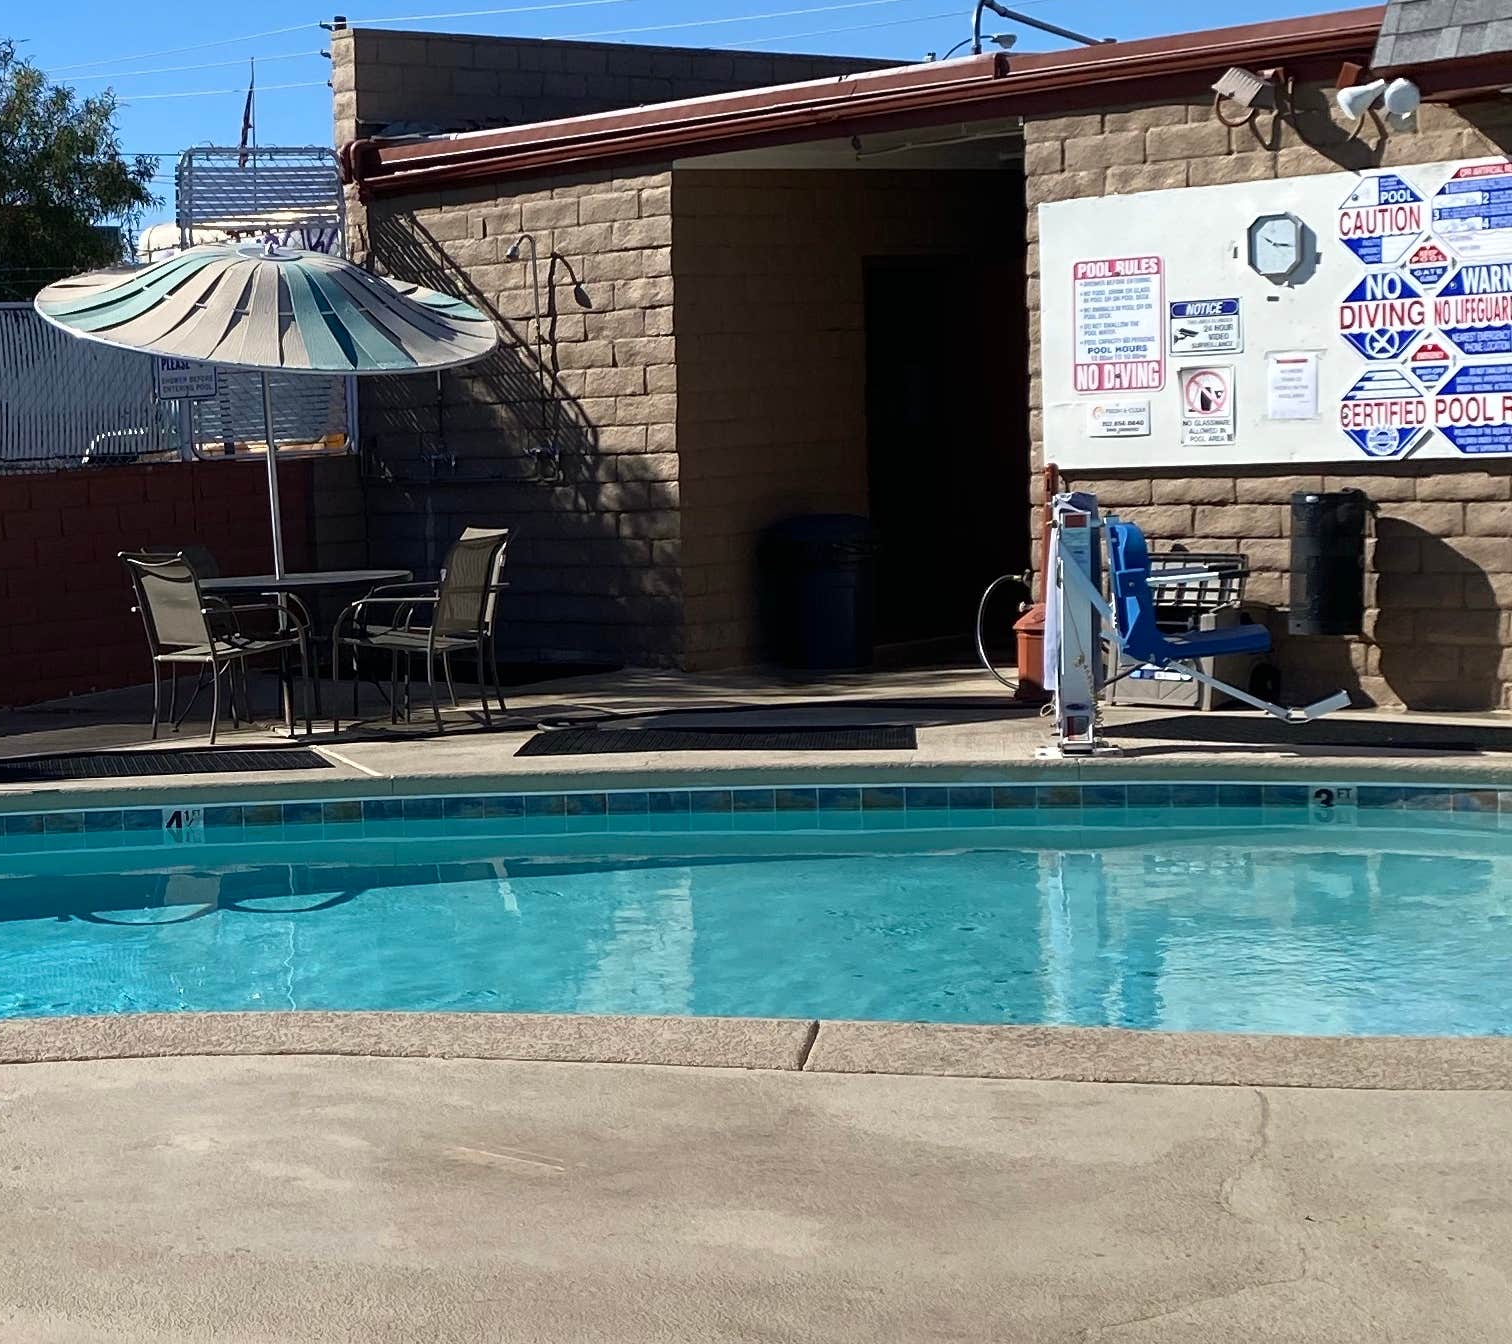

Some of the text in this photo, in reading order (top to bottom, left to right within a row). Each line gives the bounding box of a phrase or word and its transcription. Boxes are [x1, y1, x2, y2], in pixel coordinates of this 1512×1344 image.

[1380, 190, 1414, 203] POOL
[1482, 191, 1490, 204] 2
[1340, 205, 1420, 236] CAUTION
[1433, 210, 1440, 220] 3
[1077, 258, 1158, 278] POOL RULES
[1413, 268, 1443, 276] GATE
[1365, 273, 1402, 300] NO
[1186, 302, 1223, 315] NOTICE
[1340, 301, 1424, 329] DIVING
[1435, 296, 1512, 325] NO LIFEGUAR
[1115, 345, 1148, 353] HOURS
[162, 359, 190, 371] PLEASE
[1077, 361, 1160, 390] NO DIVING
[1341, 400, 1426, 428] CERTIFIED
[1436, 396, 1494, 423] POOL
[1208, 434, 1224, 442] AREA
[1314, 787, 1352, 808] 3 FT
